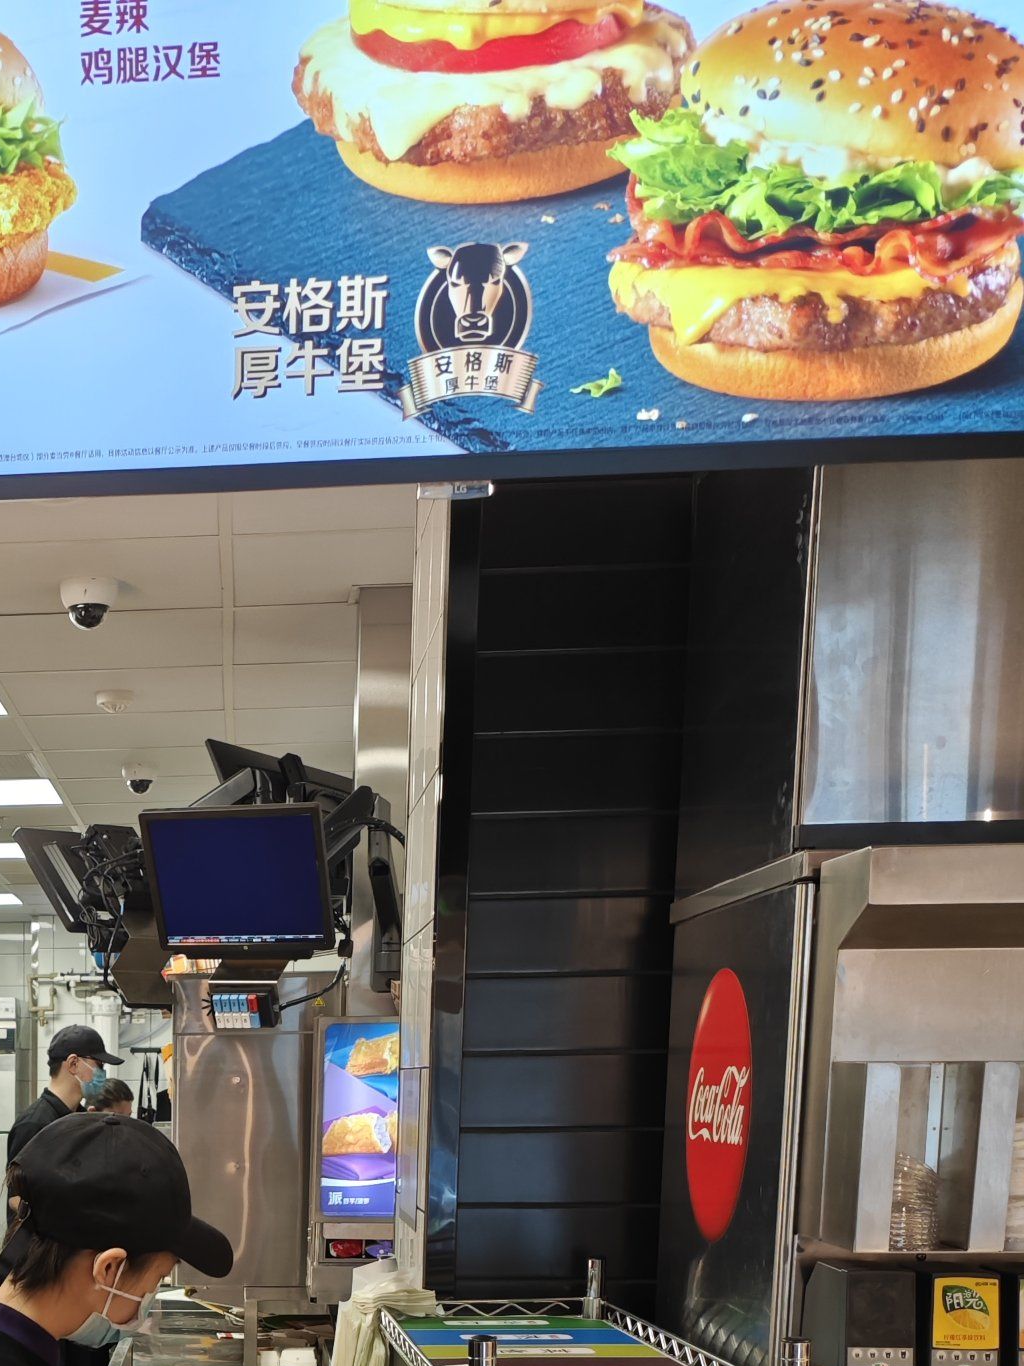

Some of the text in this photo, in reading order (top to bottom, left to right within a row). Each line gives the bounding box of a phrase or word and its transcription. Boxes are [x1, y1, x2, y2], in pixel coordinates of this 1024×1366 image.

[80, 0, 149, 37] 麦辣
[80, 41, 221, 86] 鸡腿汉堡
[233, 274, 390, 338] 安格斯
[232, 337, 386, 400] 厚牛堡
[434, 351, 515, 377] 安格斯
[445, 374, 499, 394] 厚牛堡
[687, 1065, 751, 1146] Coca-Cola
[945, 1289, 984, 1311] 阳光
